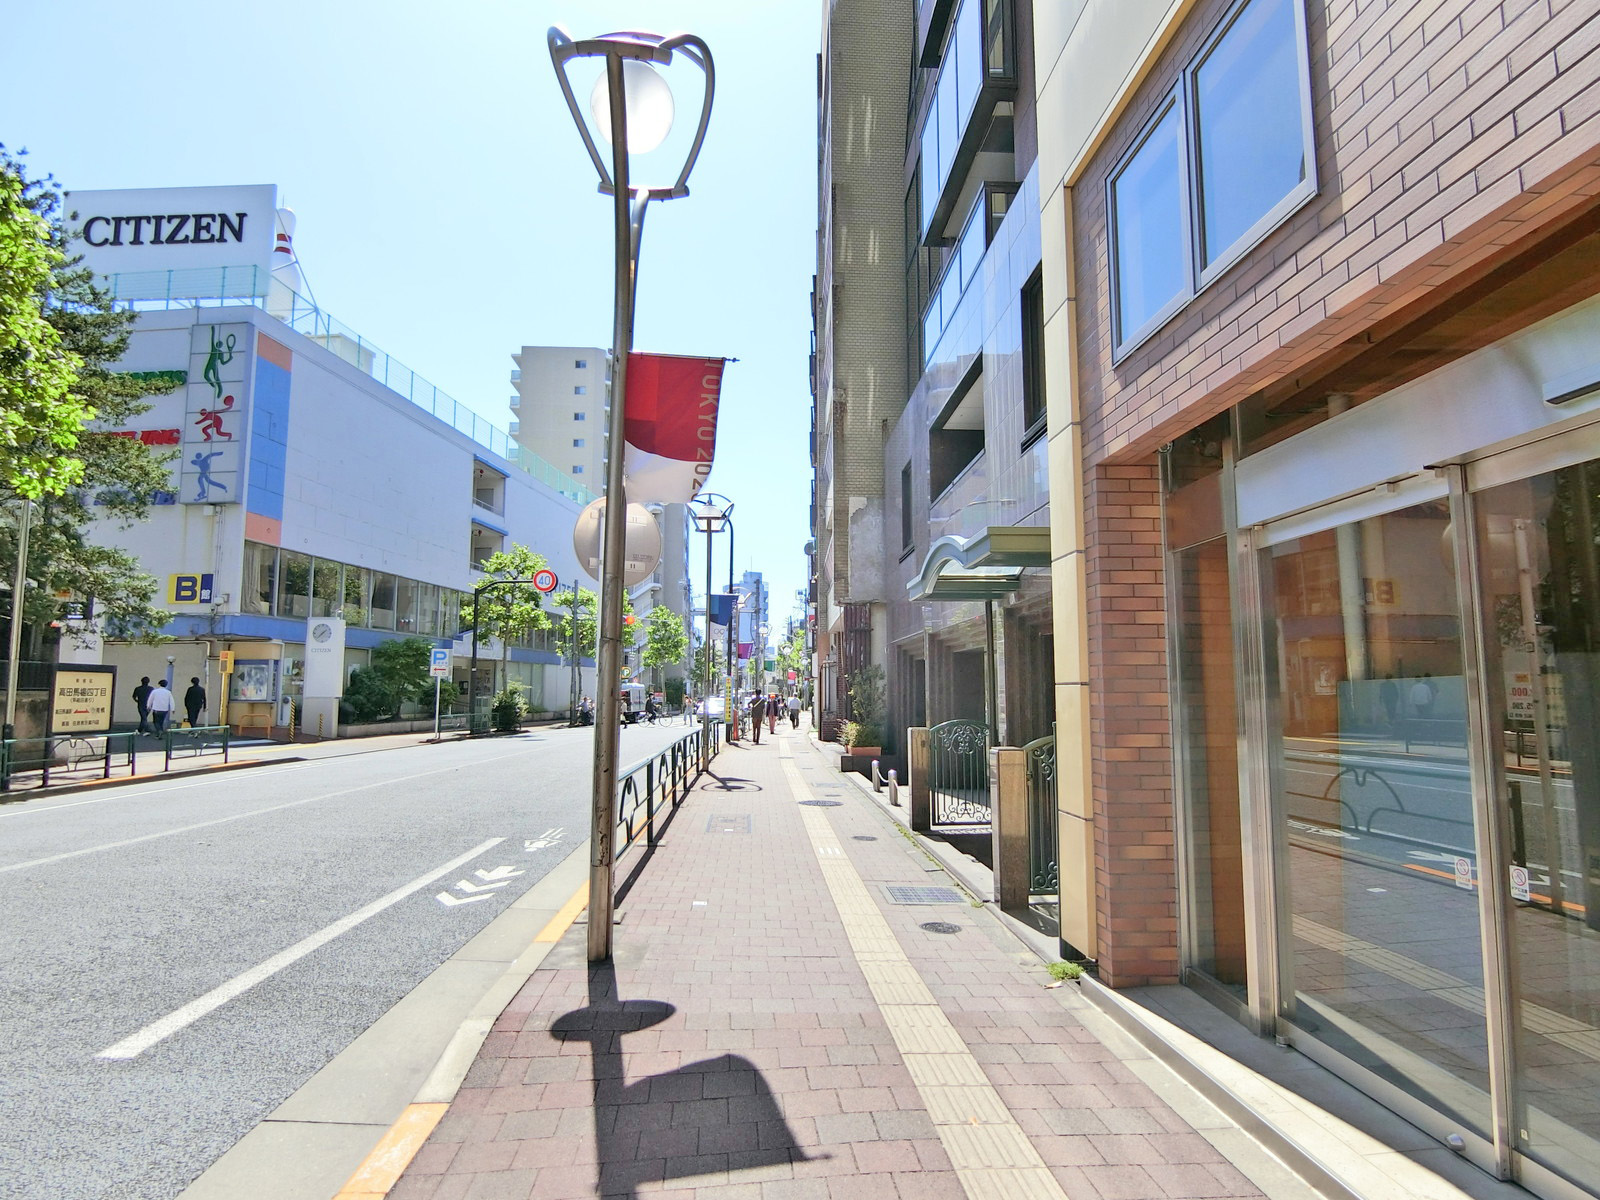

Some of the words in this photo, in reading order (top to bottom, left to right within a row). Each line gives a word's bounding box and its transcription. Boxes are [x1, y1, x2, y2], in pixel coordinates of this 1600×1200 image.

[83, 212, 248, 247] CITIZEN
[538, 575, 551, 586] 40
[433, 650, 447, 665] P
